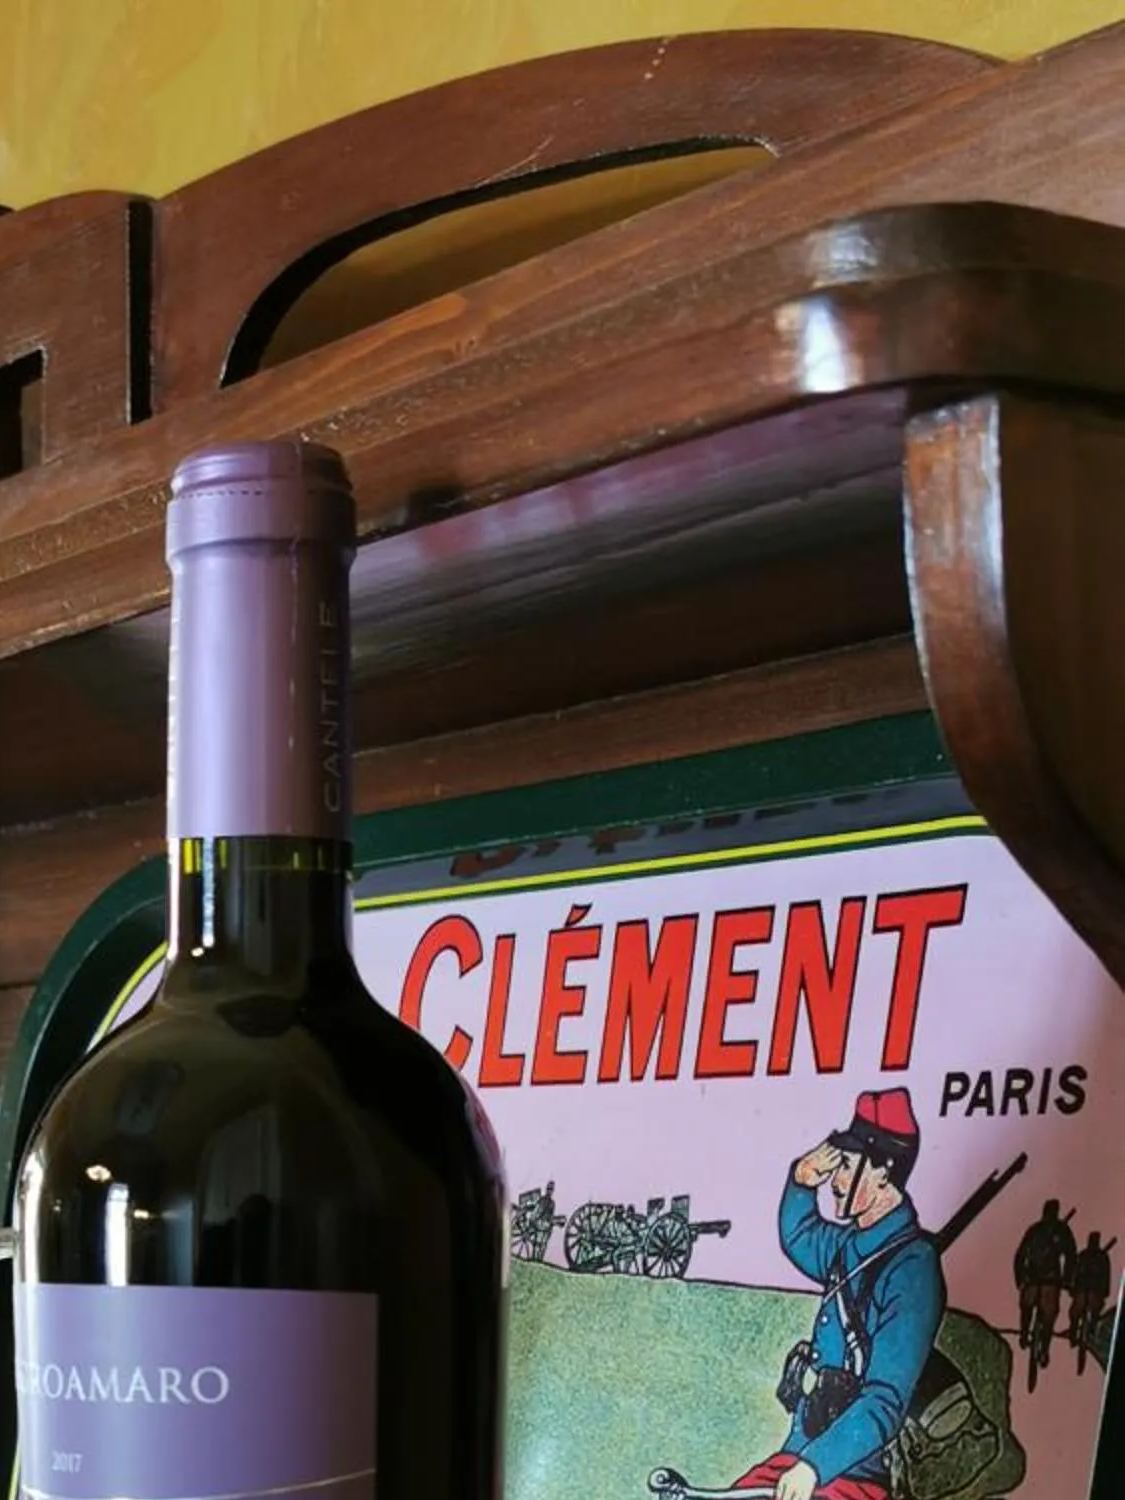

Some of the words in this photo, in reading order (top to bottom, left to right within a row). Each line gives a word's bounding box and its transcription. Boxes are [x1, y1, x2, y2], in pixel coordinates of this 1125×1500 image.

[397, 883, 969, 1088] CLÉMENT
[939, 1064, 1088, 1118] PARIS
[51, 1450, 83, 1475] 2017
